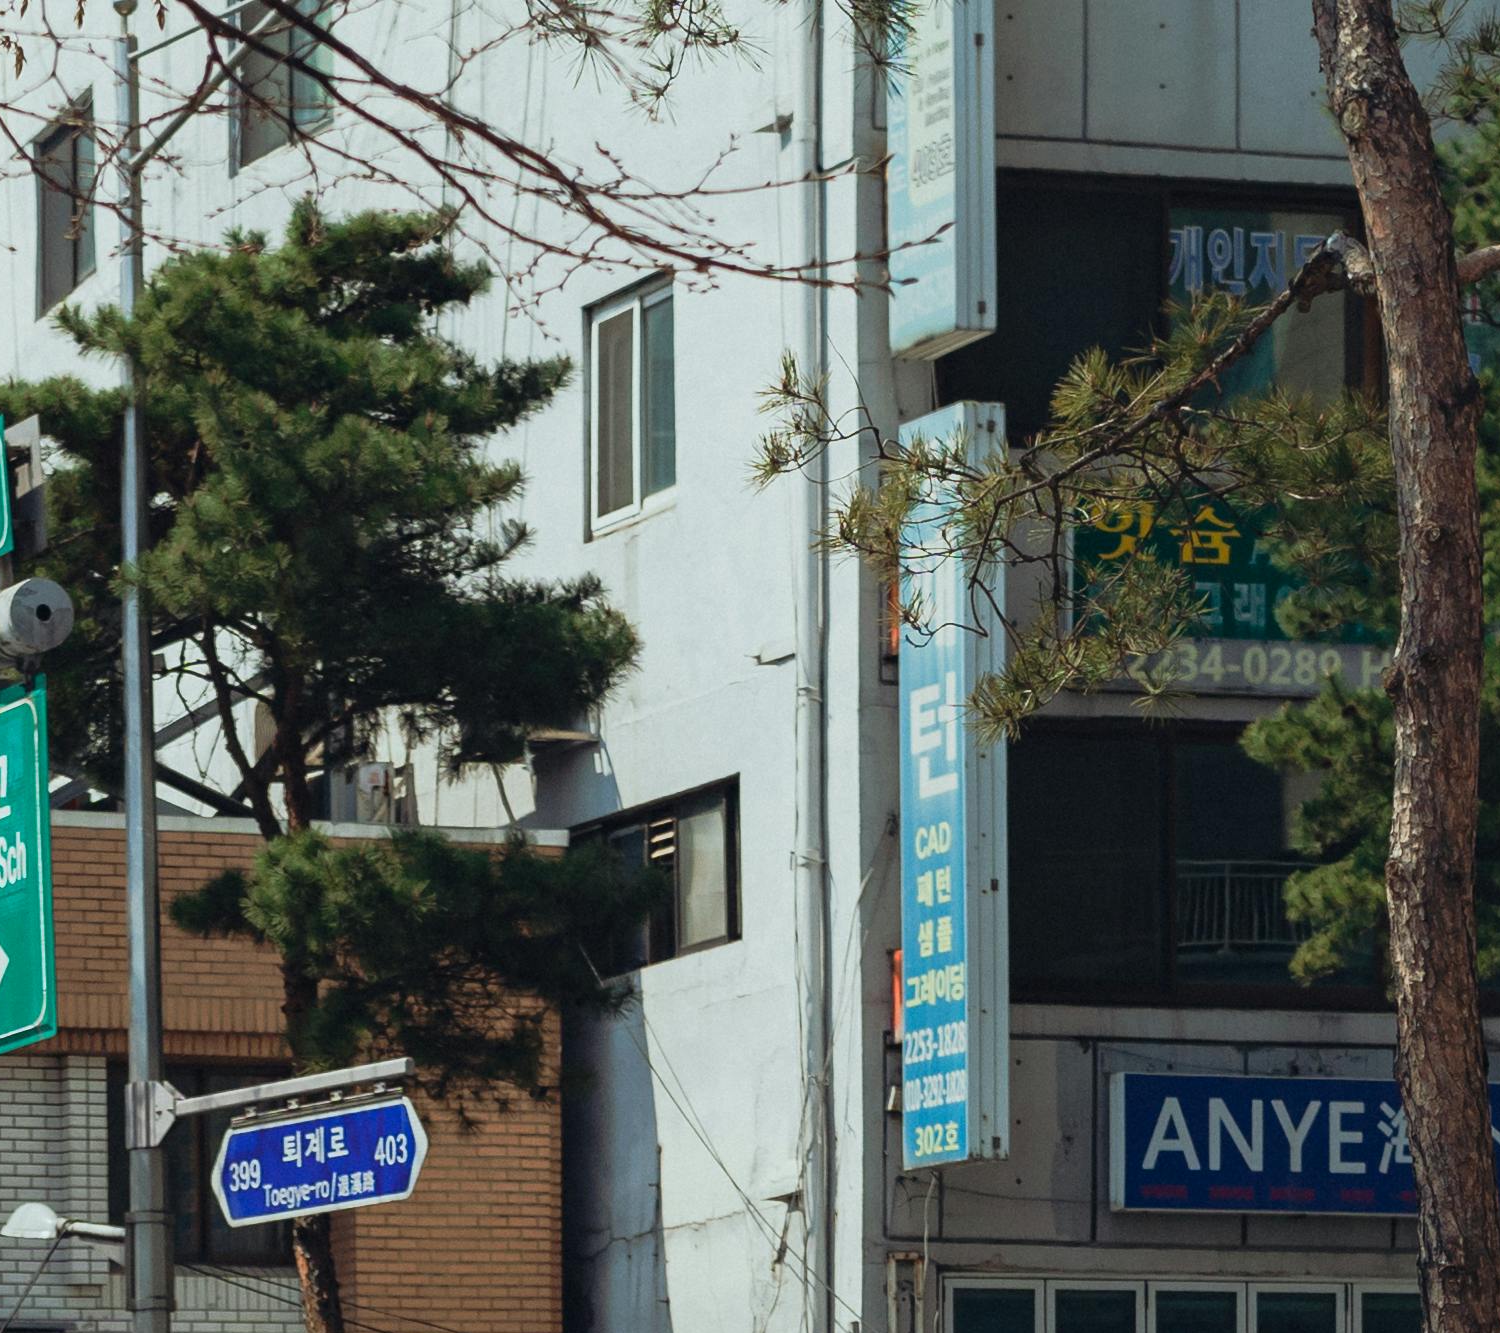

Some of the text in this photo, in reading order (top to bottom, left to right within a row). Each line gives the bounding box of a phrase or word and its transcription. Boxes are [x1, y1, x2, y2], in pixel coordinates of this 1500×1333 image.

[915, 822, 951, 860] CAD
[916, 865, 951, 907] 패턴
[917, 916, 953, 958] 샘플
[906, 961, 965, 1008] 그레이딩
[915, 1121, 959, 1157] 302호
[1141, 1096, 1366, 1175] ANYE
[229, 1126, 408, 1192] 399 퇴계로 403
